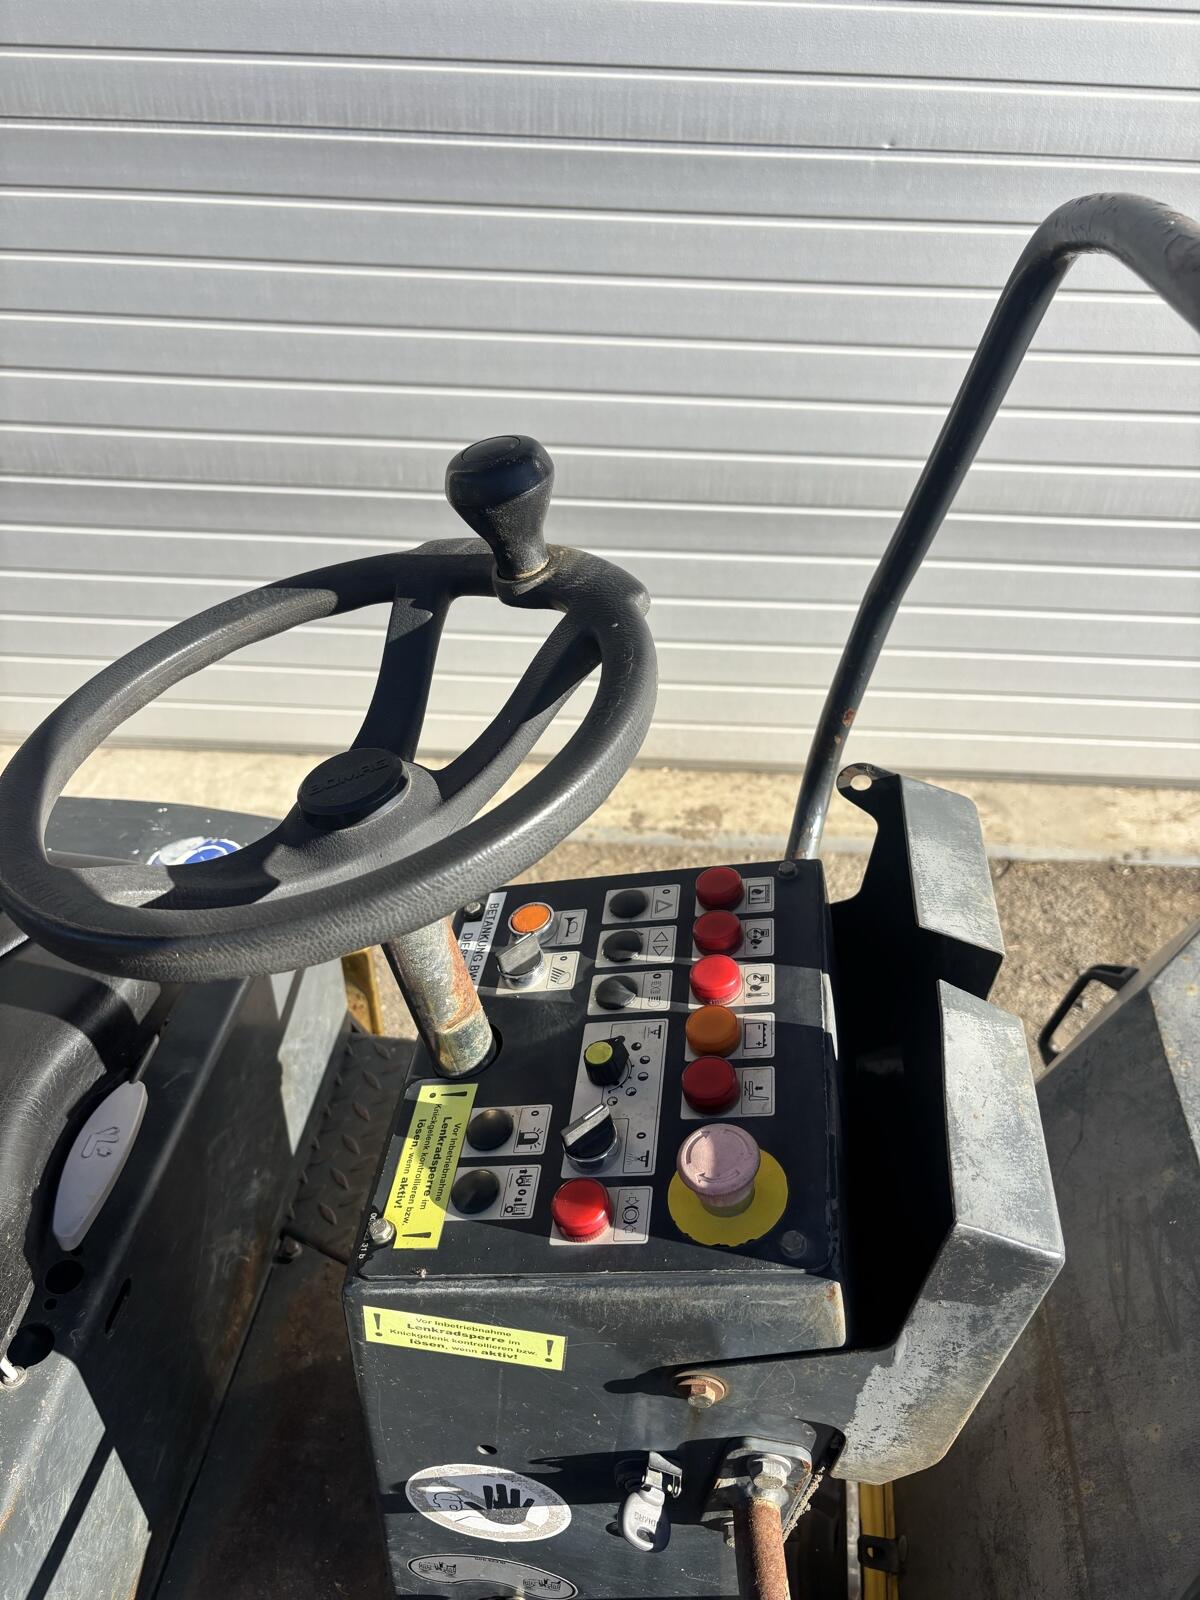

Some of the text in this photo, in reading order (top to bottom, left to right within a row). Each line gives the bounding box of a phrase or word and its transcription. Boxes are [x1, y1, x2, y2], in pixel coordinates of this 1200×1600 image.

[472, 902, 500, 962] BETANKUNG
[393, 1119, 427, 1209] lösen, wenn aktiv!
[401, 1103, 443, 1226] Knickgelenk kontrollieren bzw.
[420, 1116, 452, 1210] Lenkradsperre im
[435, 1123, 462, 1202] Vor Inbetriebnahme
[389, 1328, 538, 1356] Knickgelenk kontrollieren bzw.
[407, 1323, 505, 1343] Lenkradsperre
[415, 1317, 512, 1337] Vor Inbetriebnahme
[451, 1346, 478, 1354] wenn
[480, 1349, 518, 1360] aktiv!
